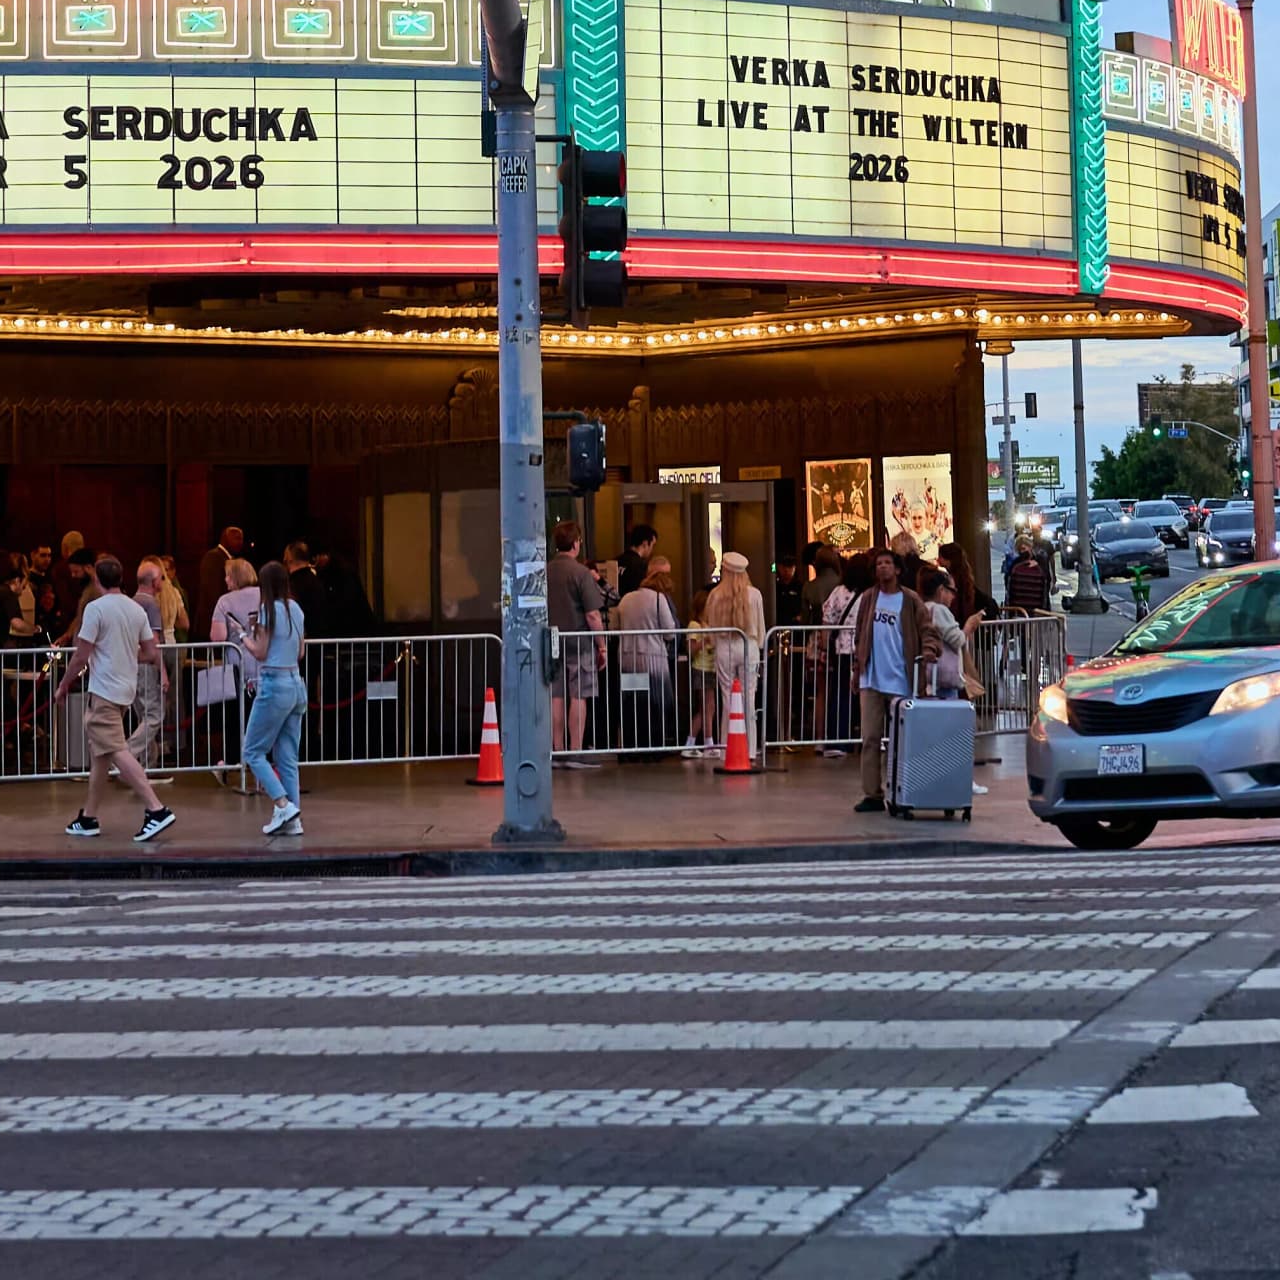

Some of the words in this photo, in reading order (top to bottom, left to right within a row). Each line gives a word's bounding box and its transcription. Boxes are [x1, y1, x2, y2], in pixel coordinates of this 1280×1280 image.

[730, 54, 830, 90] VERKA
[851, 65, 1001, 105] SERDUCHKA
[63, 106, 319, 142] SERDUCHKA
[697, 99, 768, 131] LIVE
[793, 105, 830, 134] AT
[855, 108, 900, 140] THE
[924, 115, 1028, 150] WILTERN
[64, 154, 89, 190] 5
[157, 153, 266, 191] 2026
[501, 156, 528, 174] CAPK
[849, 152, 910, 184] 2026
[501, 175, 528, 193] REEFER
[873, 611, 897, 626] USC
